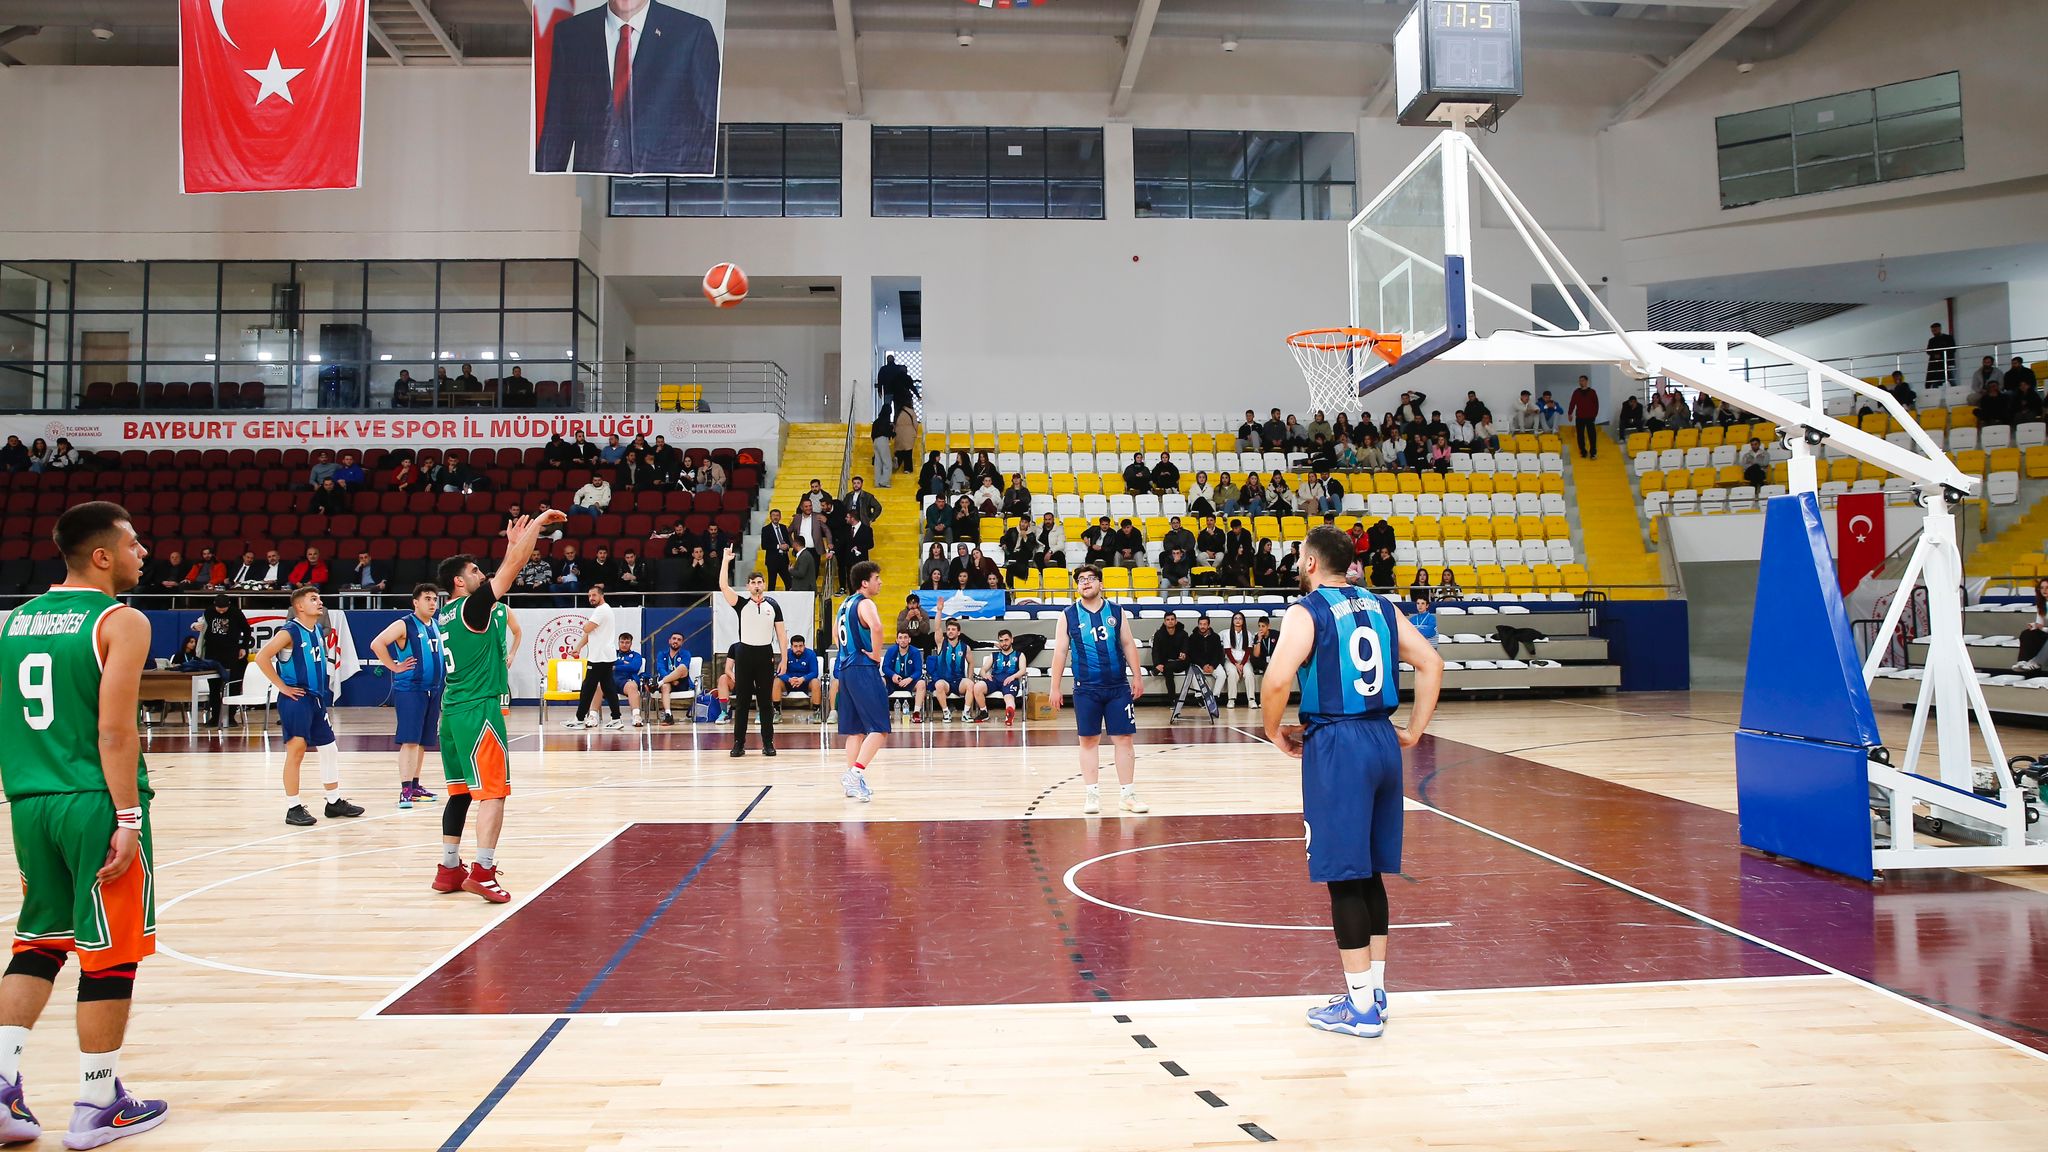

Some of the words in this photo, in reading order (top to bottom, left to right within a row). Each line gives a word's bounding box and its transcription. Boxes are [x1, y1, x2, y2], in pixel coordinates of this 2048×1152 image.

[123, 421, 237, 440] BAYBURT
[243, 416, 350, 444] GENÇLİK
[354, 420, 386, 438] VE
[391, 420, 457, 438] SPOR
[463, 416, 484, 438] İL
[490, 415, 653, 438] MÜDÜRLÜĞÜ
[28, 608, 91, 636] ÜNİVERSİTESİ
[1090, 625, 1109, 642] 13
[310, 646, 322, 663] 12
[427, 638, 439, 653] 17
[1349, 625, 1384, 697] 9
[18, 652, 55, 731] 9
